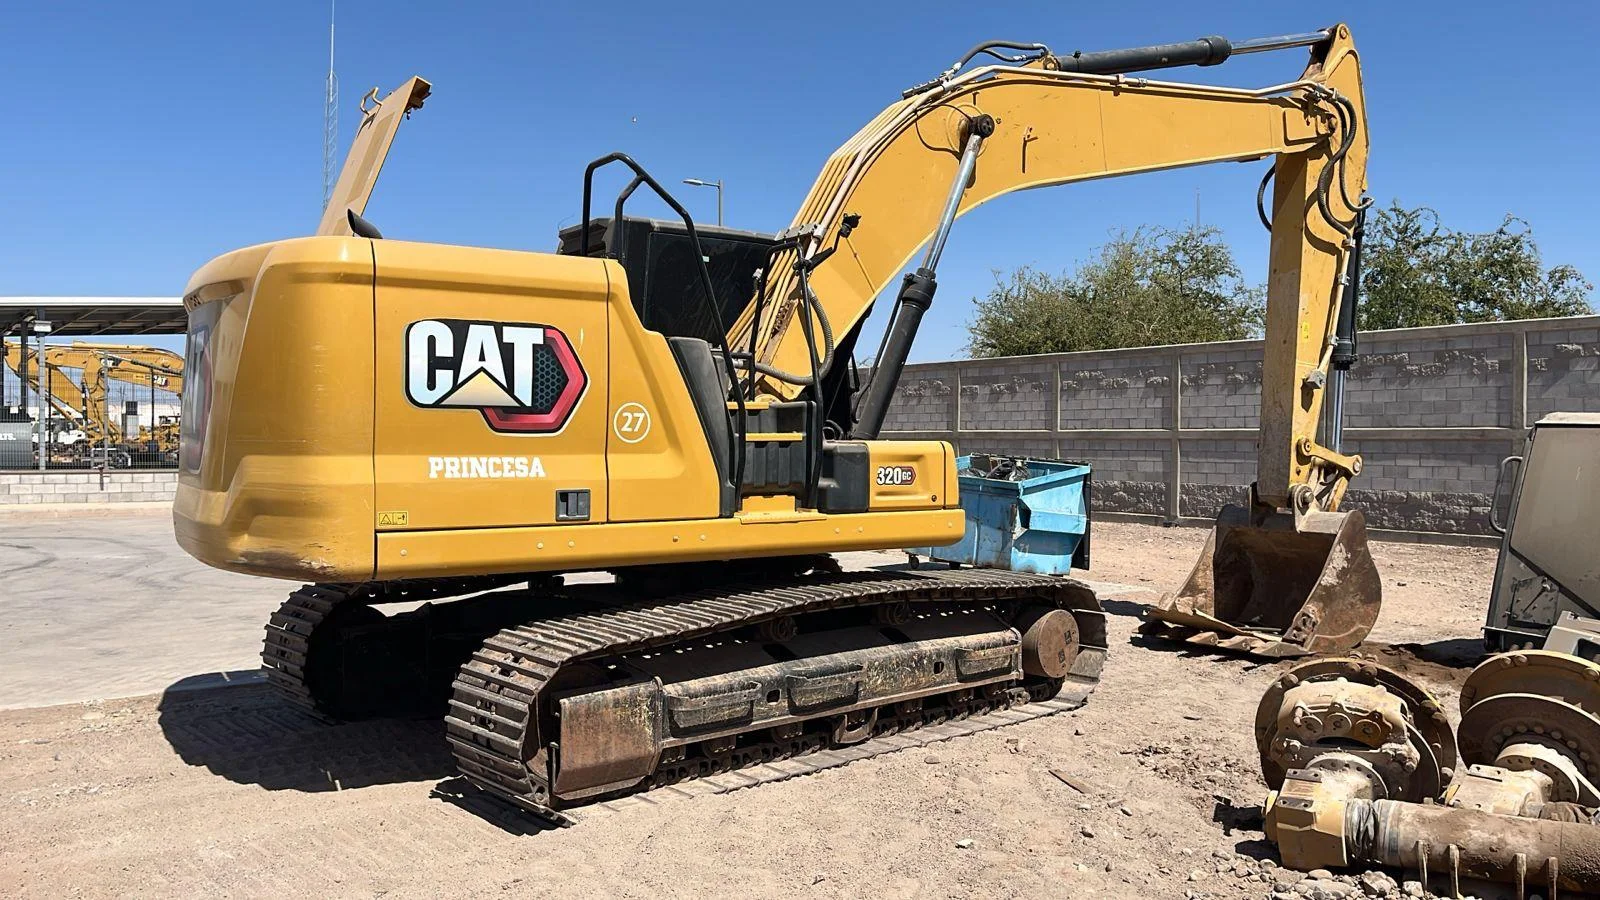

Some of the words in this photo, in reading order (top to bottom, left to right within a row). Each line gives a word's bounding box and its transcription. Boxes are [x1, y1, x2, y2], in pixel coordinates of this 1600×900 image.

[409, 321, 544, 407] CAT
[621, 412, 646, 432] 27
[428, 456, 546, 479] PRINCESA
[876, 467, 902, 485] 320
[902, 471, 912, 480] GC
